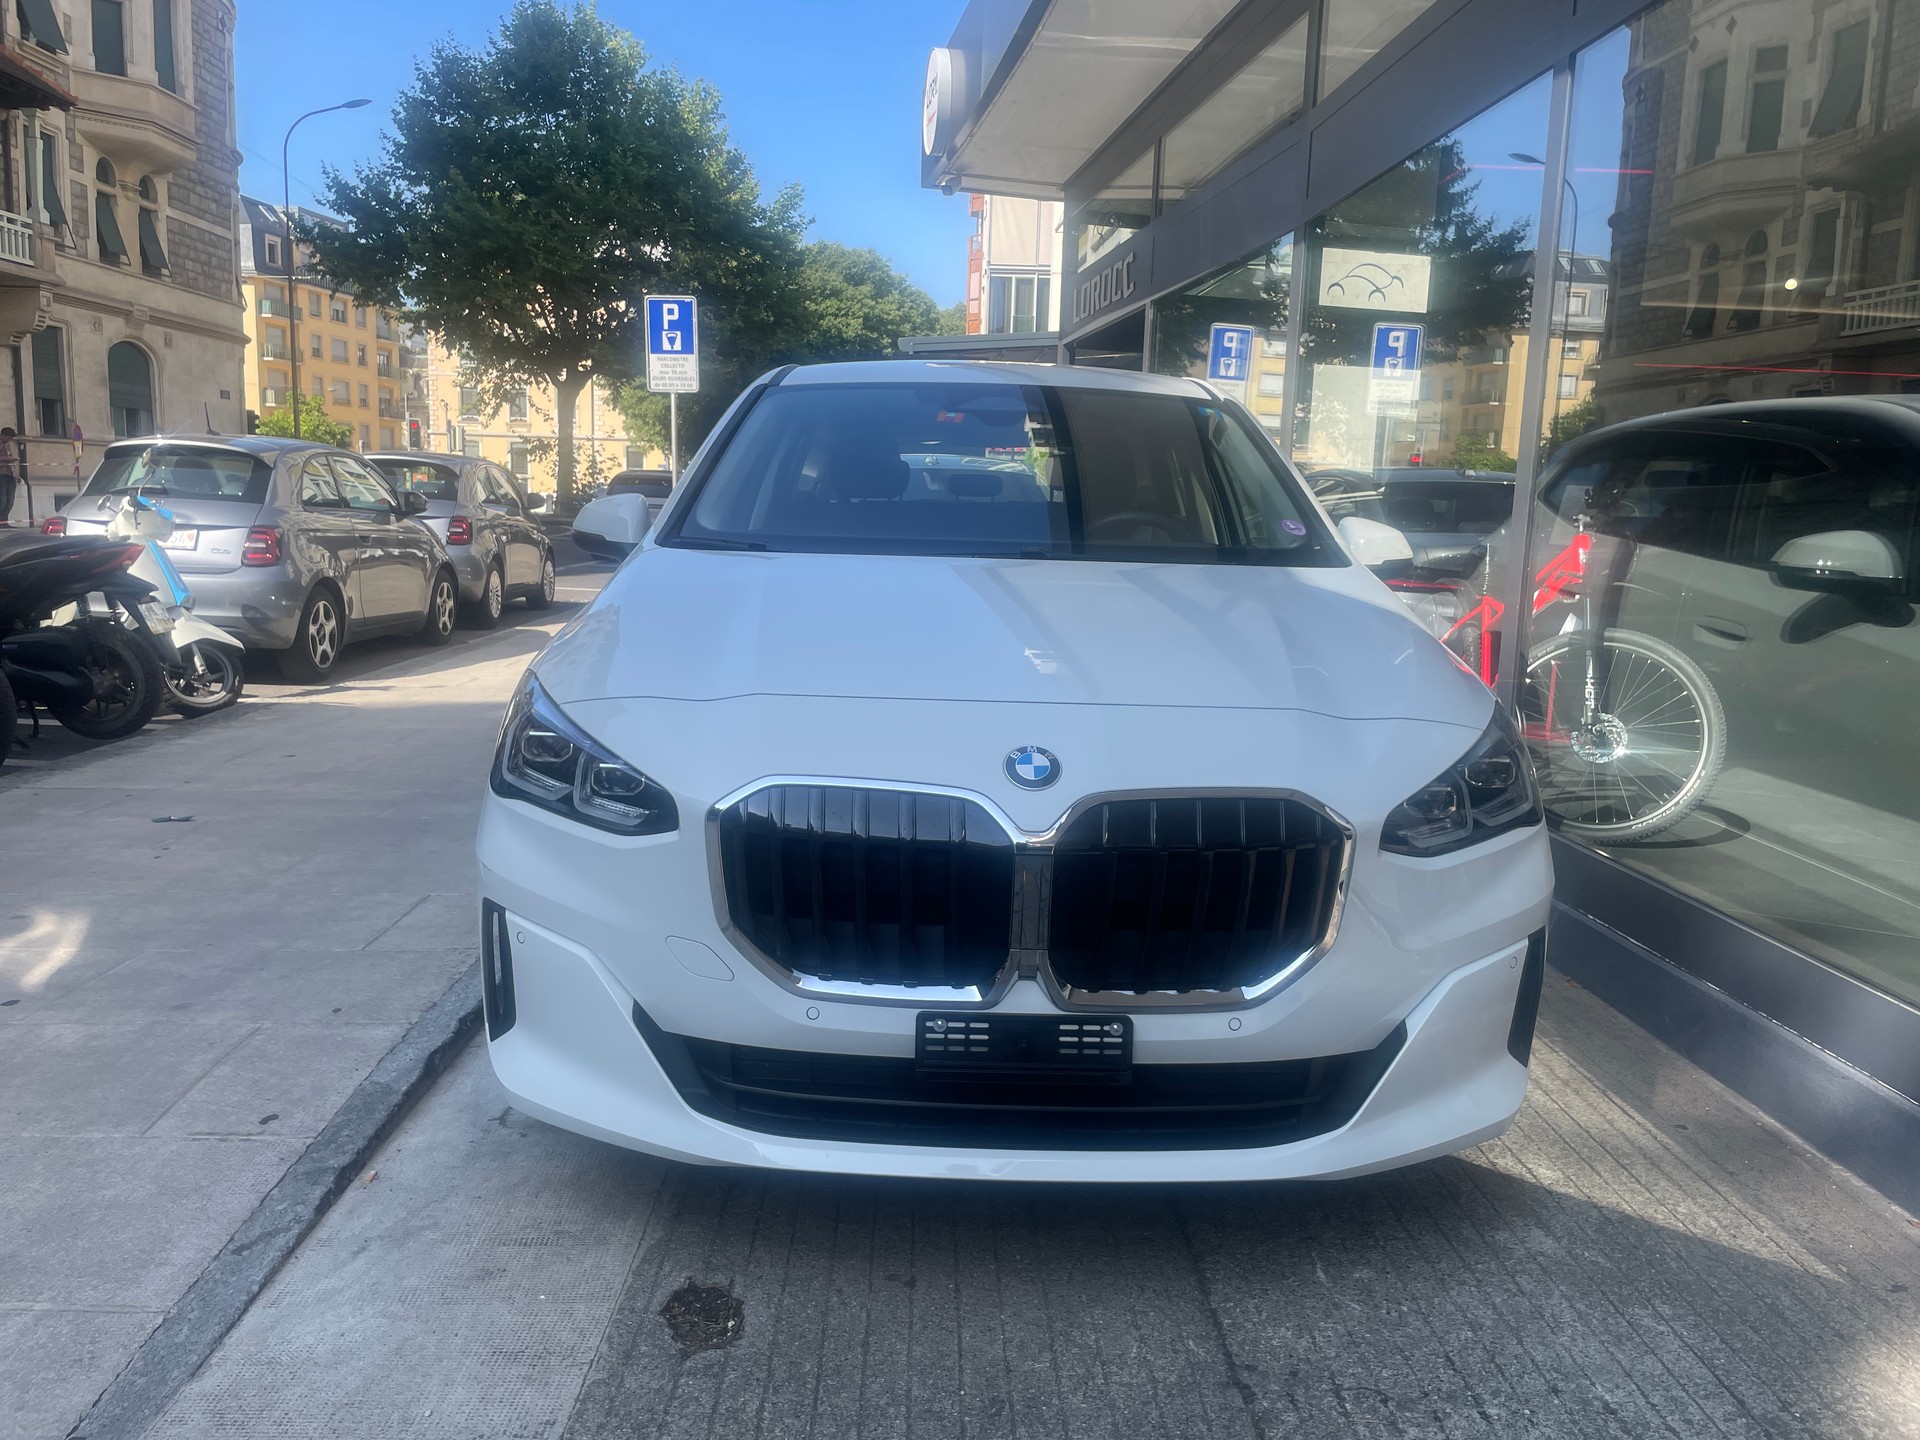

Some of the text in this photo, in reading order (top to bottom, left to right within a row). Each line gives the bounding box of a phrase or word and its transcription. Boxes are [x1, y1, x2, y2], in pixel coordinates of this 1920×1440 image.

[1073, 251, 1134, 324] LOROCC
[663, 303, 679, 330] P
[1010, 746, 1056, 760] BMW
